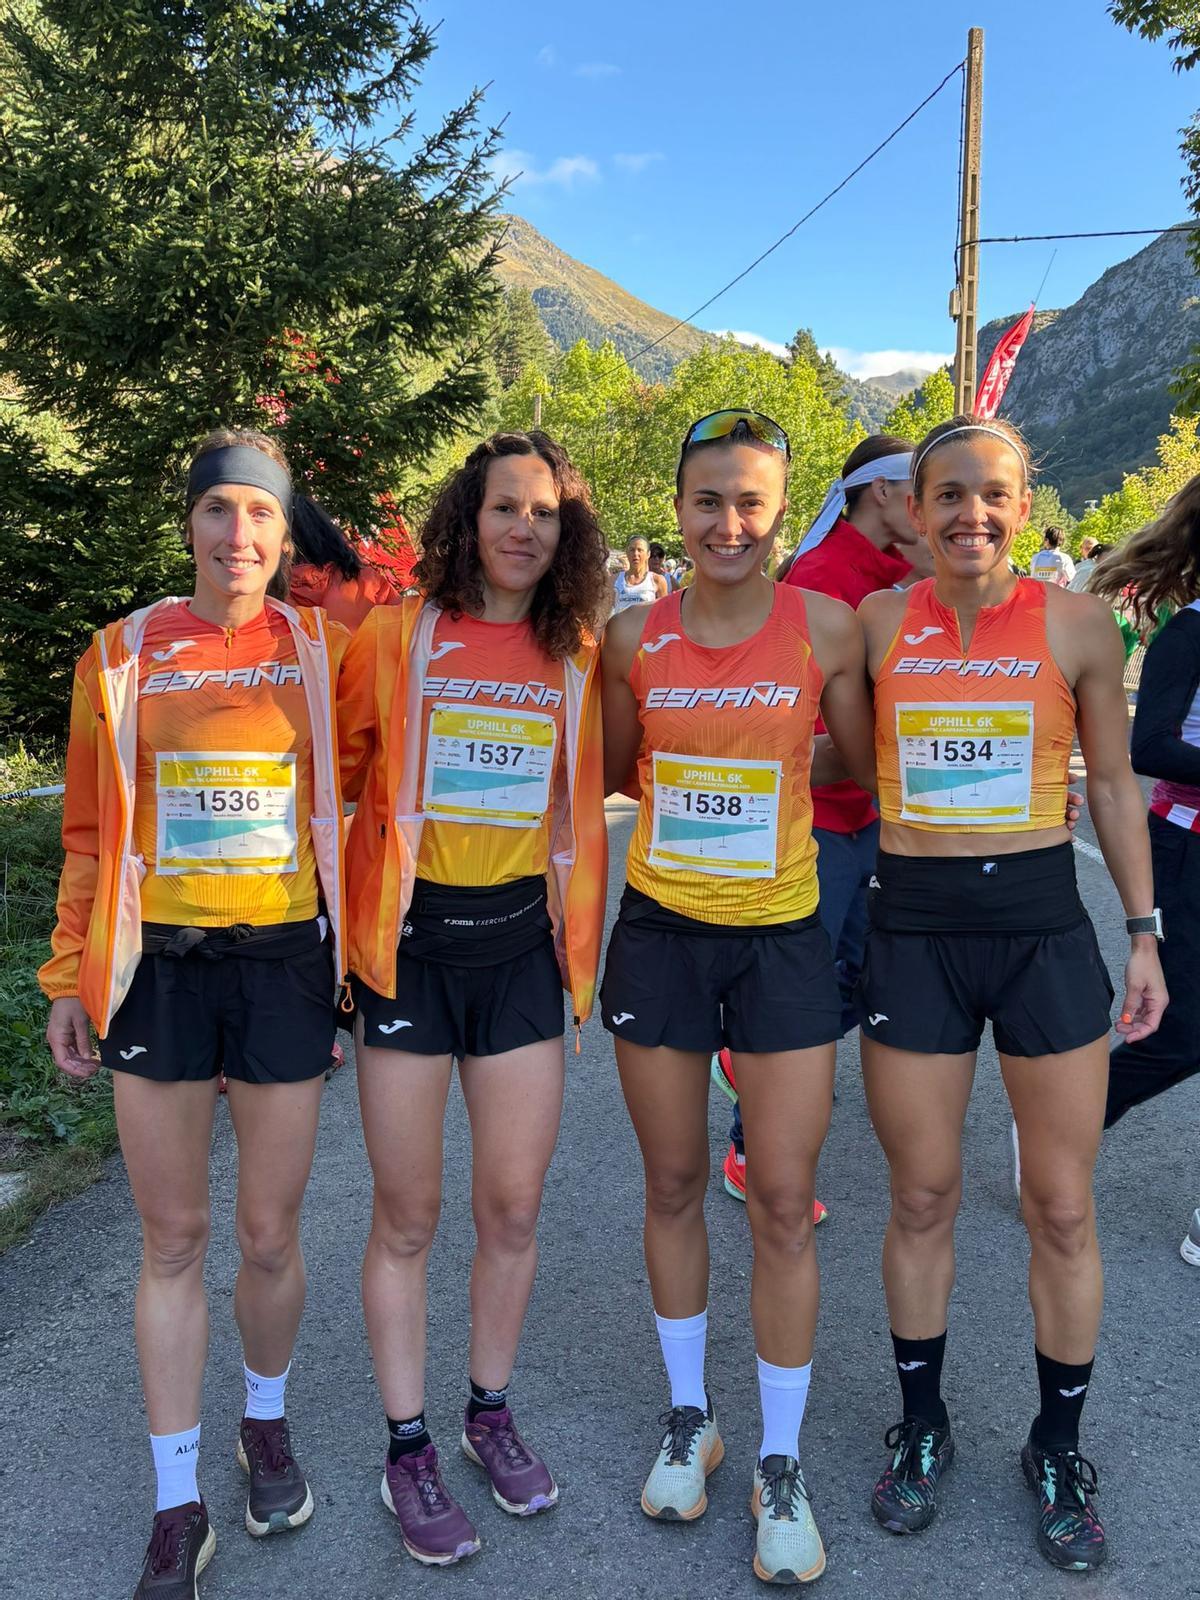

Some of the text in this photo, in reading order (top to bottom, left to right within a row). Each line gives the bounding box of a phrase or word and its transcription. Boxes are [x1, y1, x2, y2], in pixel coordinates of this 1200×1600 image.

[140, 661, 303, 695] ESPAÑA
[892, 656, 1042, 679] ESPAÑA
[422, 677, 565, 709] ESPAÑA
[645, 681, 802, 709] ESPAÑA
[467, 719, 526, 734] UPHILL 6K
[929, 717, 994, 727] UPHILL 6K
[465, 741, 524, 767] 1537
[930, 739, 993, 762] 1534
[194, 766, 259, 777] UPHILL 6K
[683, 769, 725, 782] UPHILL
[727, 773, 743, 784] 6K
[195, 789, 260, 812] 1536
[682, 791, 742, 817] 1538
